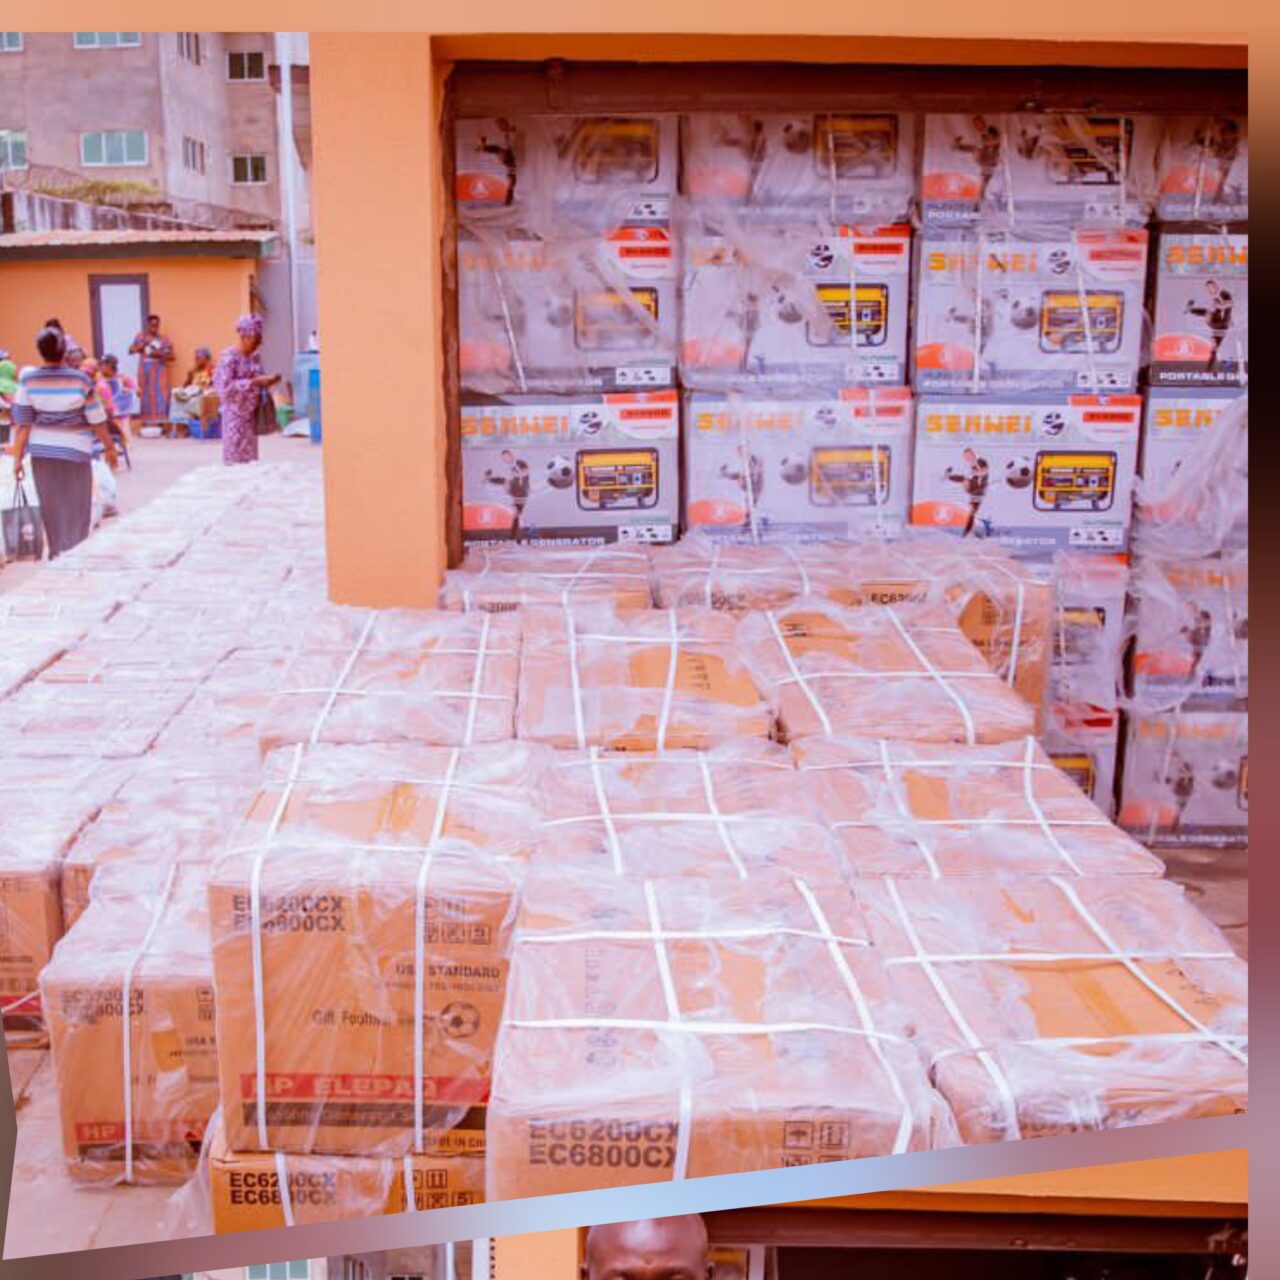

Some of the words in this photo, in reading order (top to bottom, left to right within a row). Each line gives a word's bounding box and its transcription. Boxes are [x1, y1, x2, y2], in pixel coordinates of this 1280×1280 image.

[926, 413, 1033, 434] SENWEI
[428, 963, 501, 979] STANDARD
[229, 1172, 336, 1189] EC620CX
